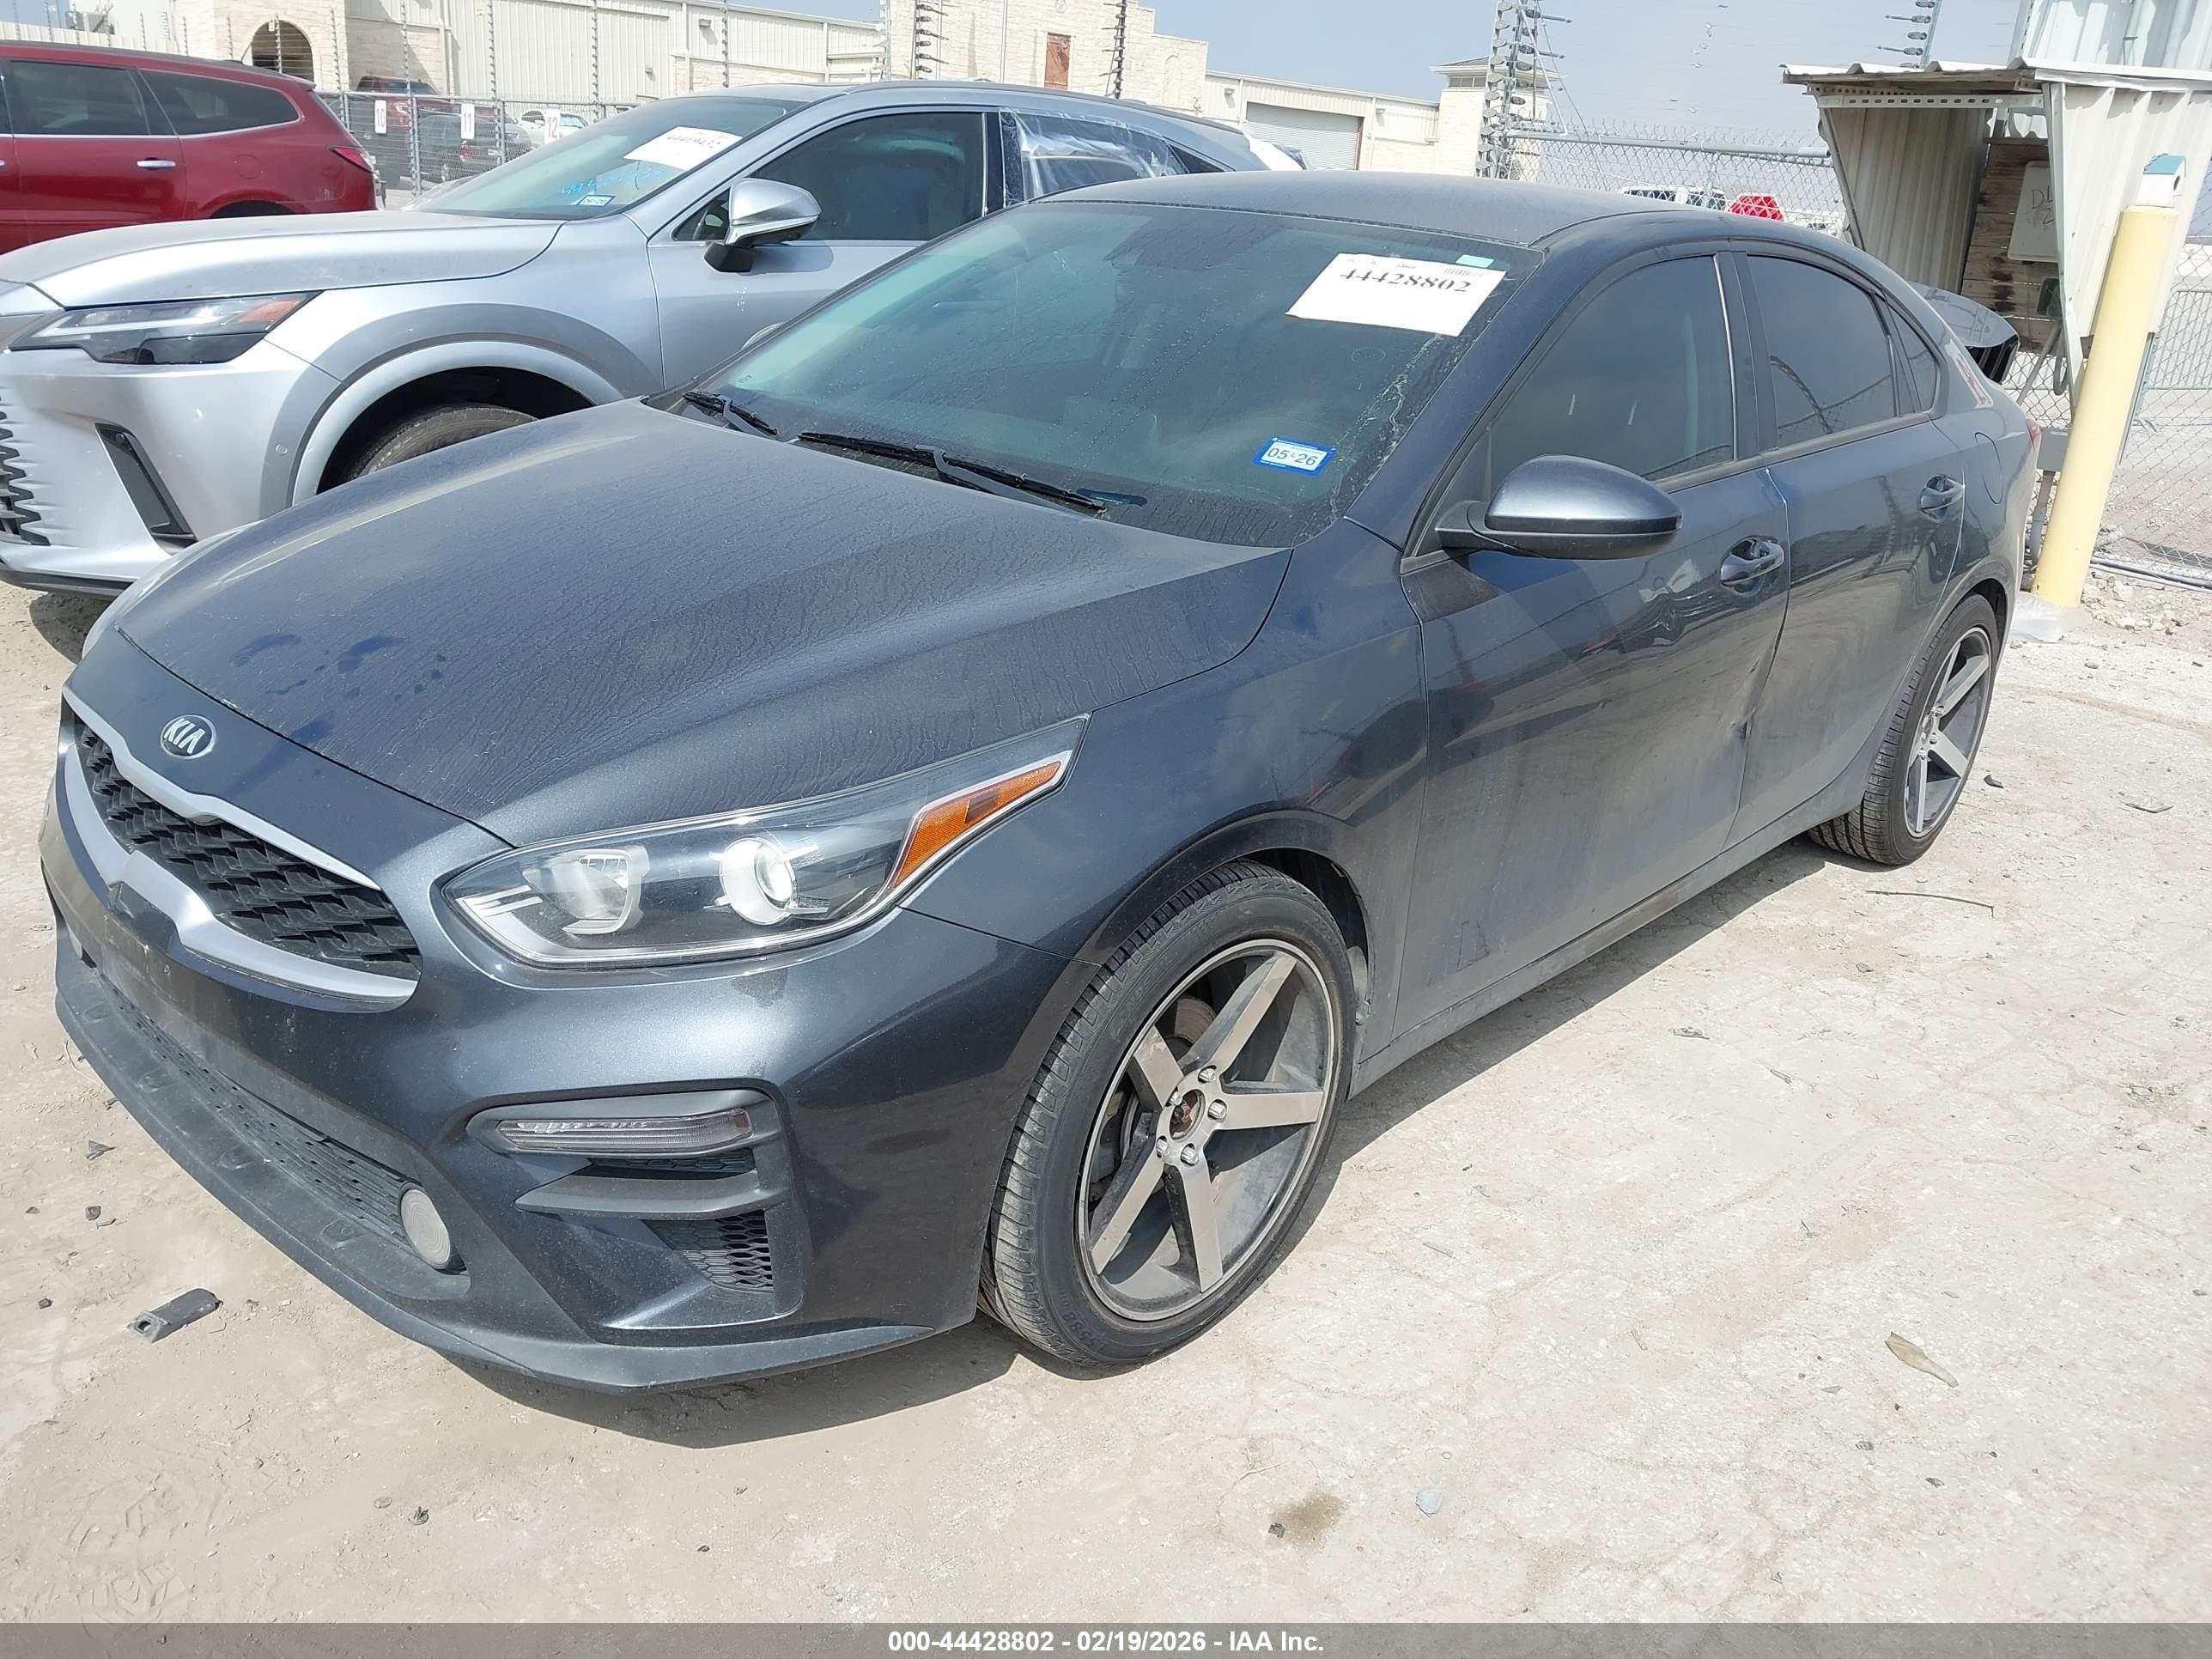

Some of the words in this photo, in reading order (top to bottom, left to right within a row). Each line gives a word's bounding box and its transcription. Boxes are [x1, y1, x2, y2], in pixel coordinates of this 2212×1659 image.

[376, 107, 386, 127] 10
[463, 112, 471, 131] 11
[546, 116, 558, 138] 12
[1340, 269, 1472, 293] 44428802
[1267, 447, 1290, 459] 05
[1294, 453, 1319, 466] 26
[163, 717, 206, 755] KIA
